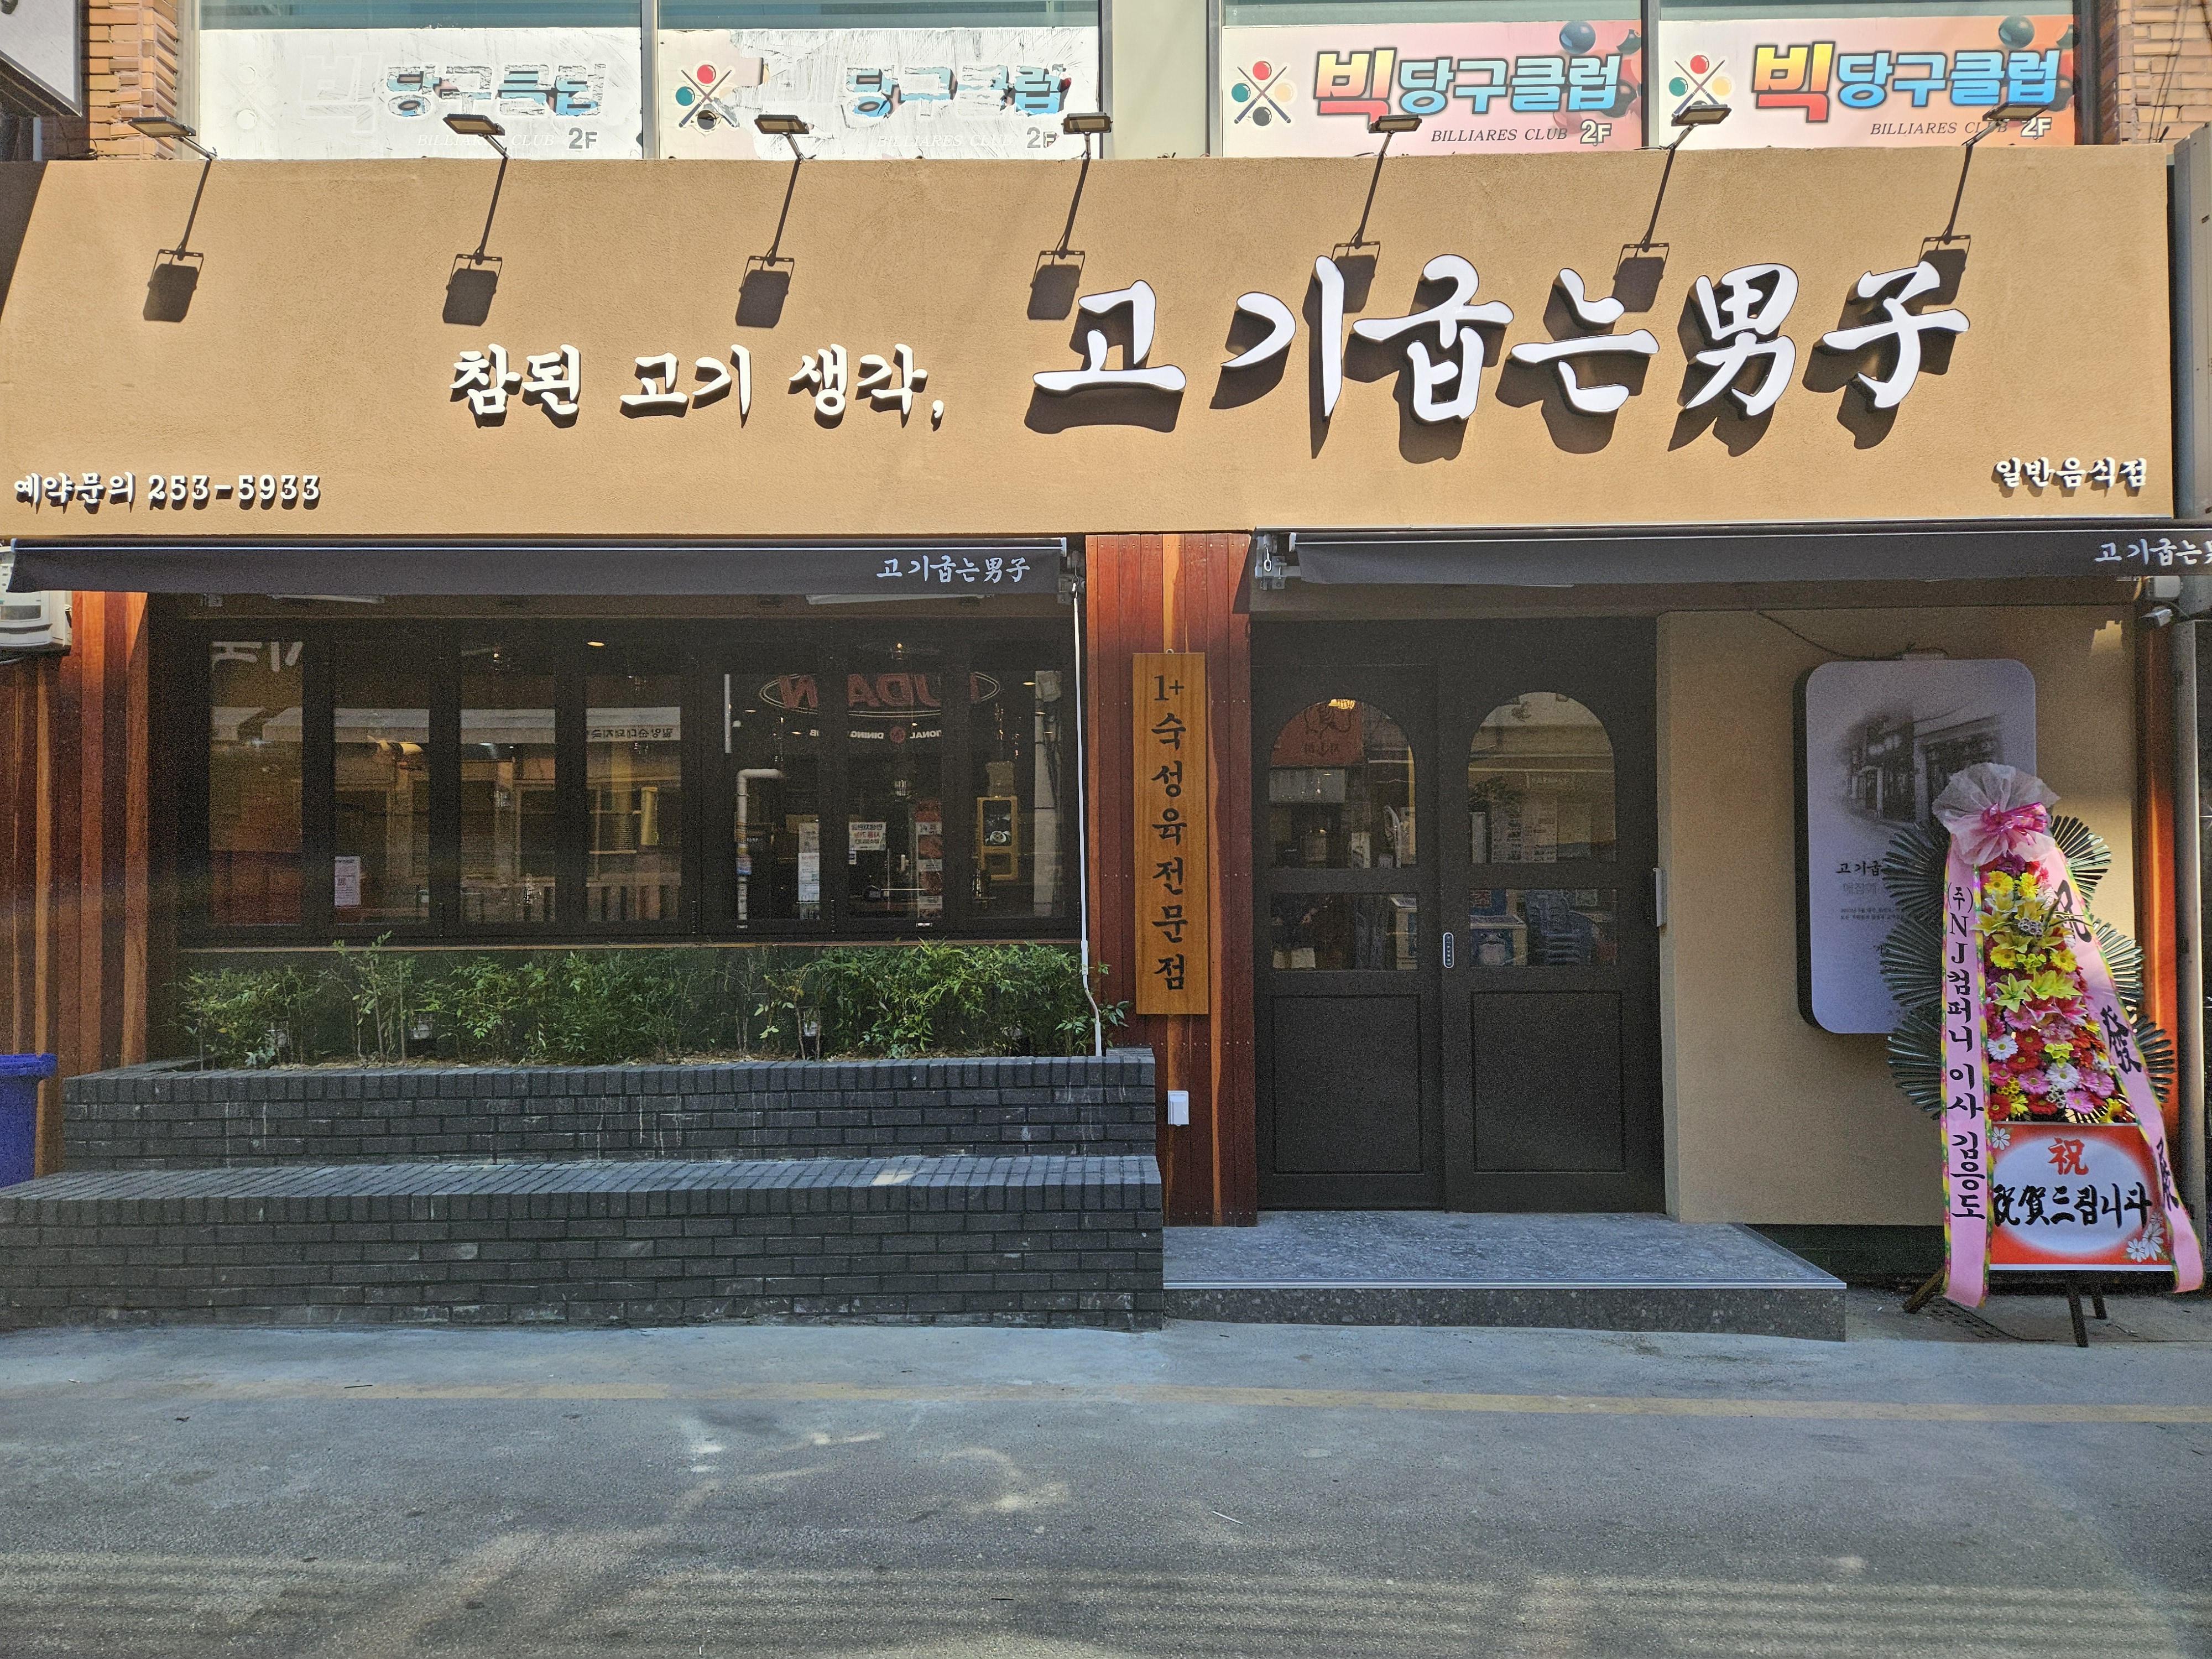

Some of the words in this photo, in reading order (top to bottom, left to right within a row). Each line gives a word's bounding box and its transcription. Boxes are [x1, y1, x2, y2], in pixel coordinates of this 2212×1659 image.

[418, 134, 504, 147] BILLIARS
[511, 134, 555, 147] CLUB
[568, 127, 598, 149] 2F
[1026, 127, 1057, 149] 2F
[1431, 129, 1517, 142] BILLIARES
[1524, 128, 1568, 140] CLUB
[1579, 119, 1612, 144] 2F
[1870, 122, 1958, 135] BILLIARES
[2021, 117, 2053, 138] 2F
[450, 344, 581, 415] 참된
[619, 343, 752, 415] 고기
[789, 343, 945, 419] 생각,
[1996, 457, 2147, 488] 일반음식점
[14, 471, 135, 504] 예약문의
[147, 473, 320, 501] 253-5933
[2094, 538, 2212, 566] 고기굽는
[877, 555, 1030, 583] 고기굽는男子
[1835, 860, 1882, 877] 고기굽
[1947, 1063, 1984, 1120] 이사
[2048, 1137, 2089, 1176] 祝
[1950, 1131, 1986, 1220] 김응도
